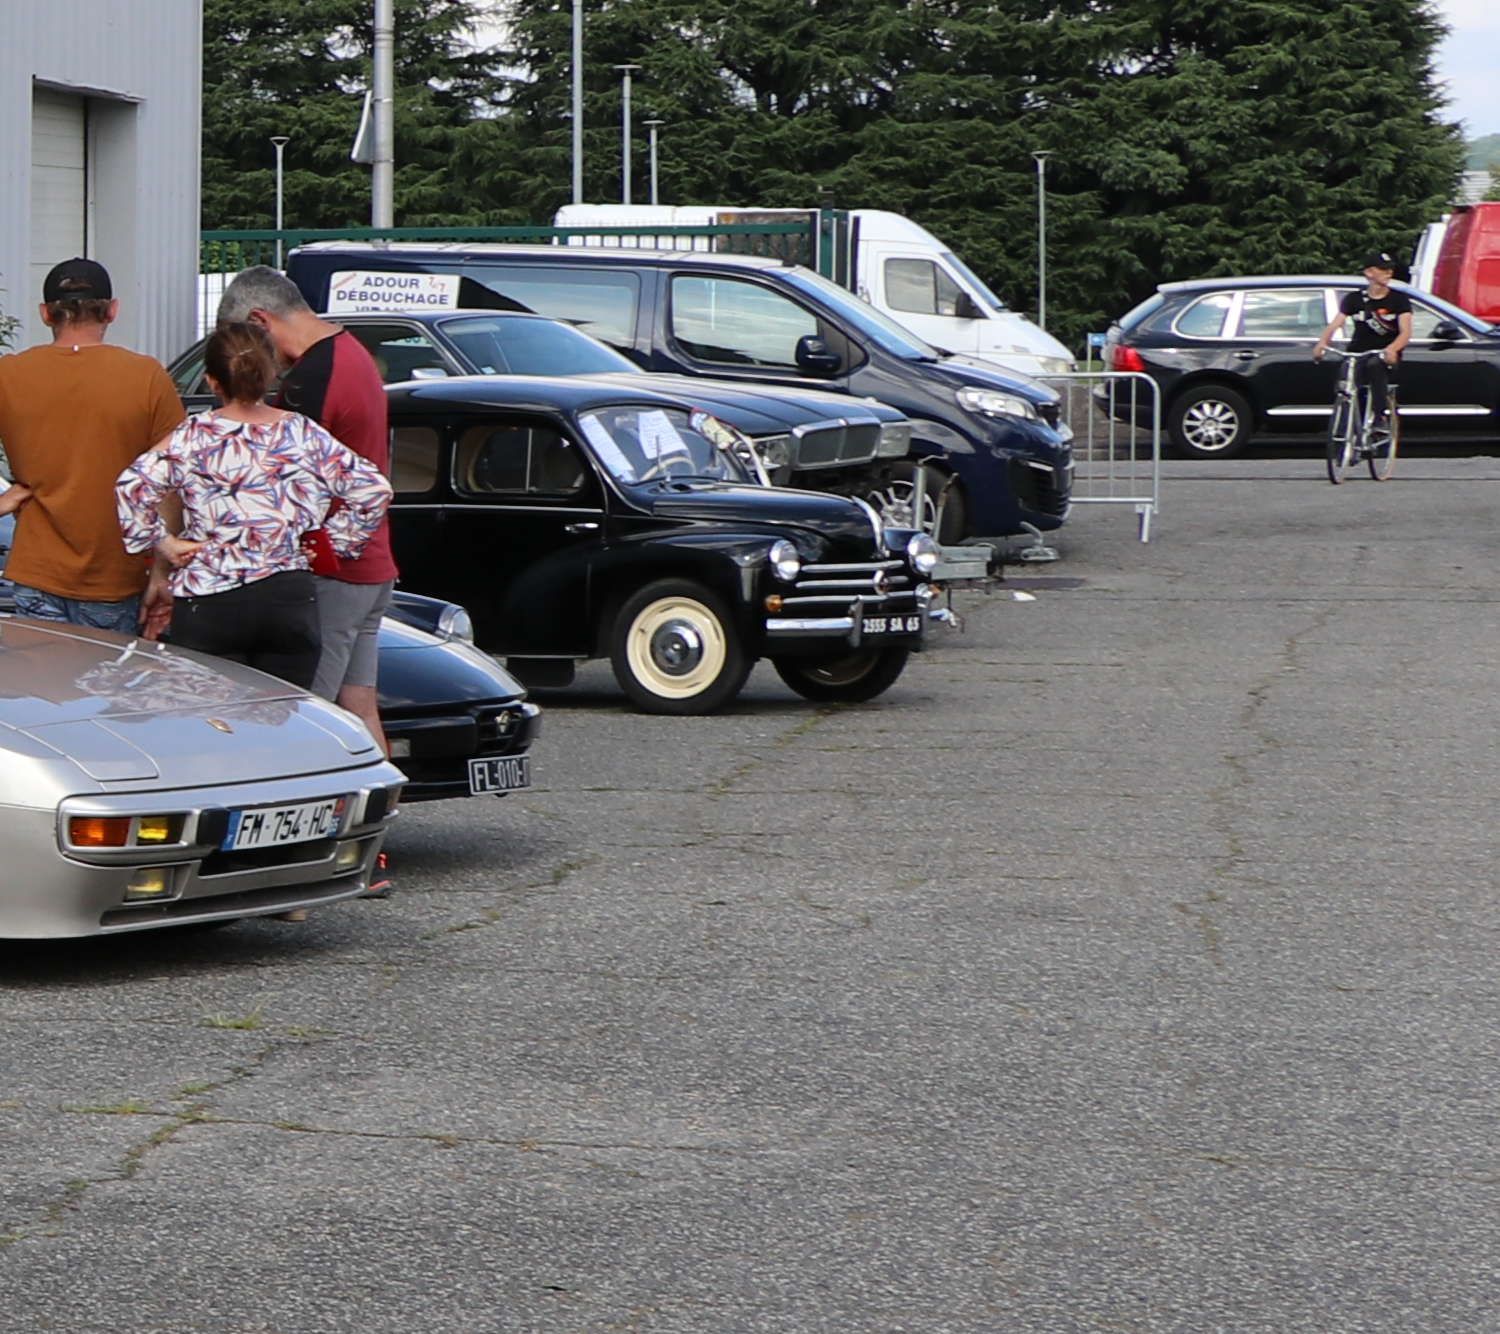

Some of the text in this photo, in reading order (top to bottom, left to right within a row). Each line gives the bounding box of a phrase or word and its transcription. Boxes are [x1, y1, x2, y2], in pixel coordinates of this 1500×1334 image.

[362, 276, 420, 289] ADOUR
[336, 288, 449, 305] DÉBOUCHAGE
[236, 804, 333, 845] FM-754-HC
